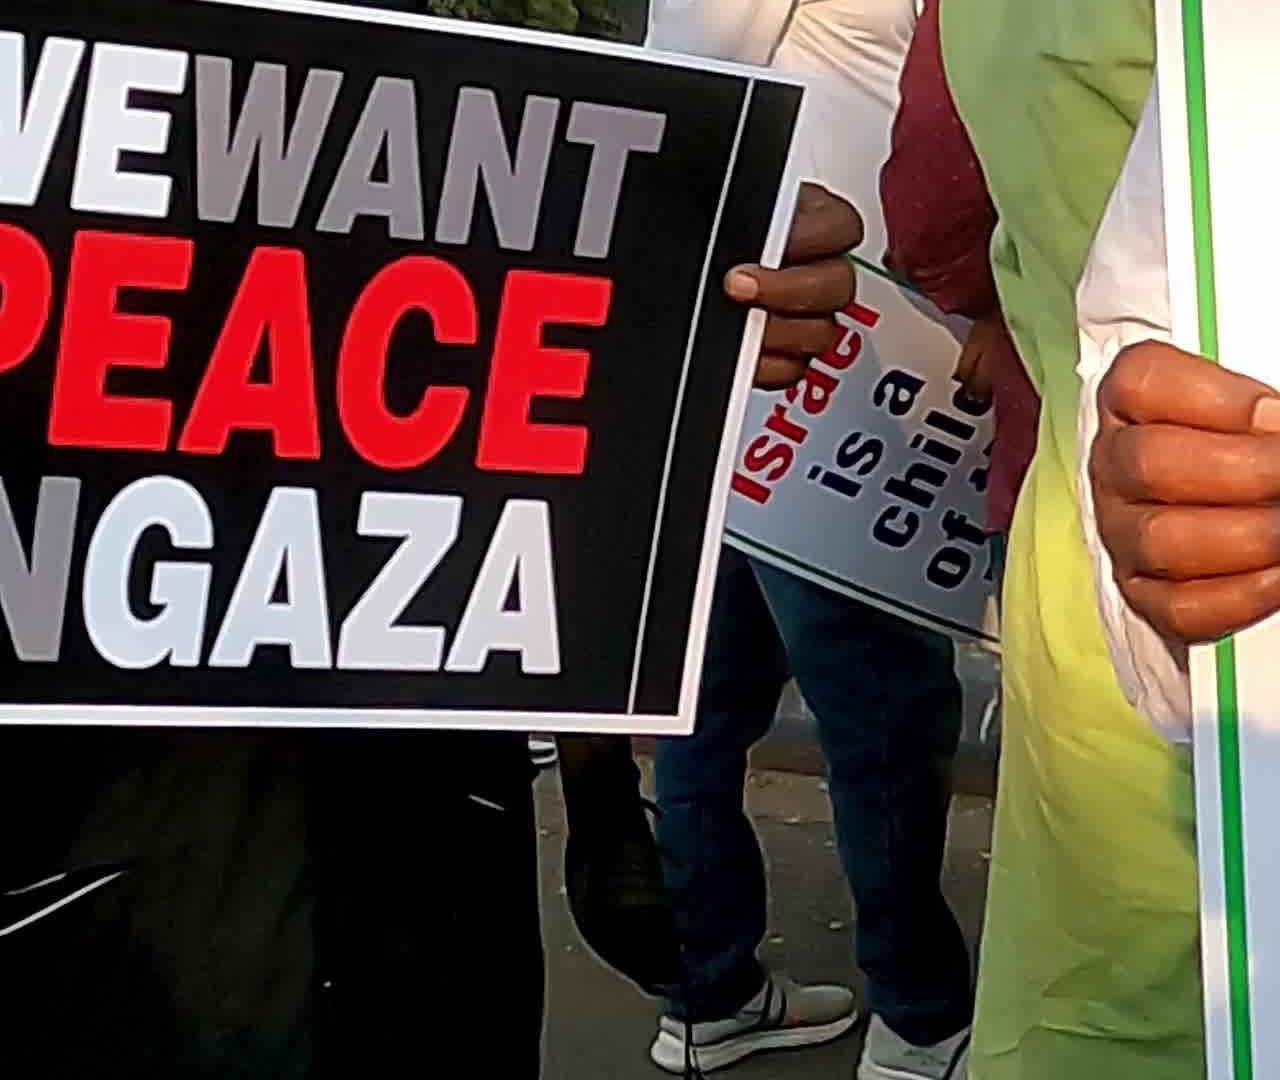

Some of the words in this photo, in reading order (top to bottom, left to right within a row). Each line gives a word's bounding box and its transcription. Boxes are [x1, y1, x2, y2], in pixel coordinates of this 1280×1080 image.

[195, 54, 667, 259] WANT
[807, 431, 884, 498] is
[873, 369, 926, 416] a
[82, 475, 561, 675] GAZA
